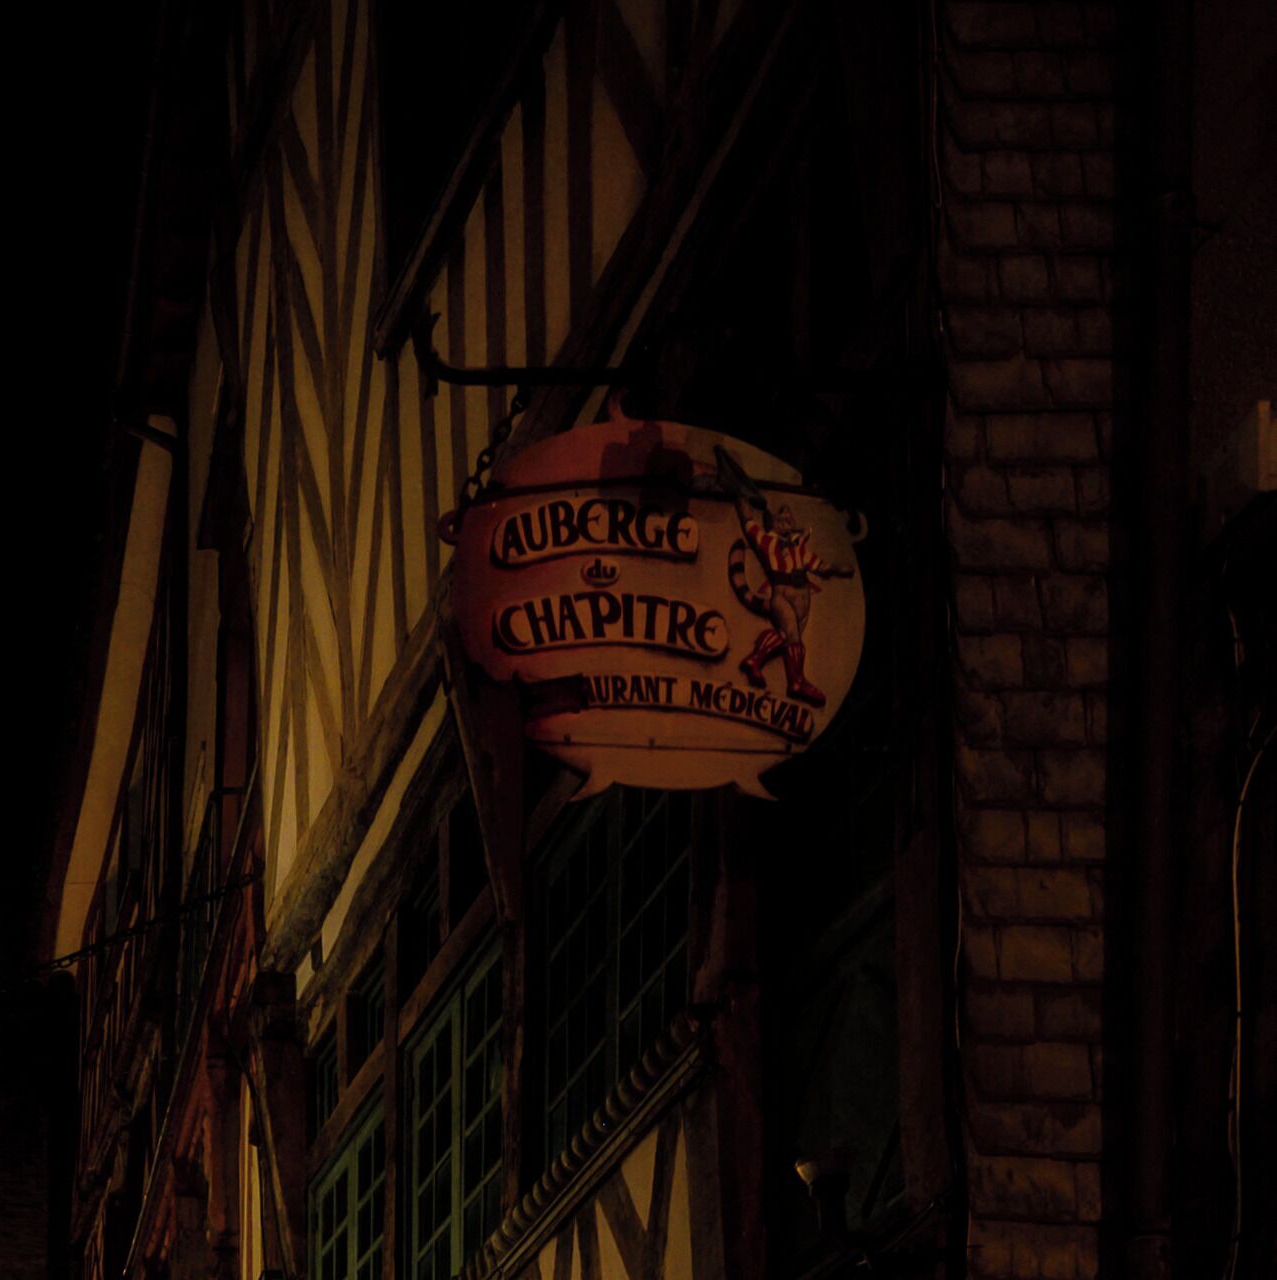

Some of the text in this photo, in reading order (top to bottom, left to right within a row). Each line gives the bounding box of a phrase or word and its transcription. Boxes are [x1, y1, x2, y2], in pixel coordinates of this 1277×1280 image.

[501, 498, 693, 561] AUBERGE
[586, 558, 617, 579] du
[499, 591, 722, 652] CHAPITRE
[689, 680, 813, 736] MÉDIÉVAL
